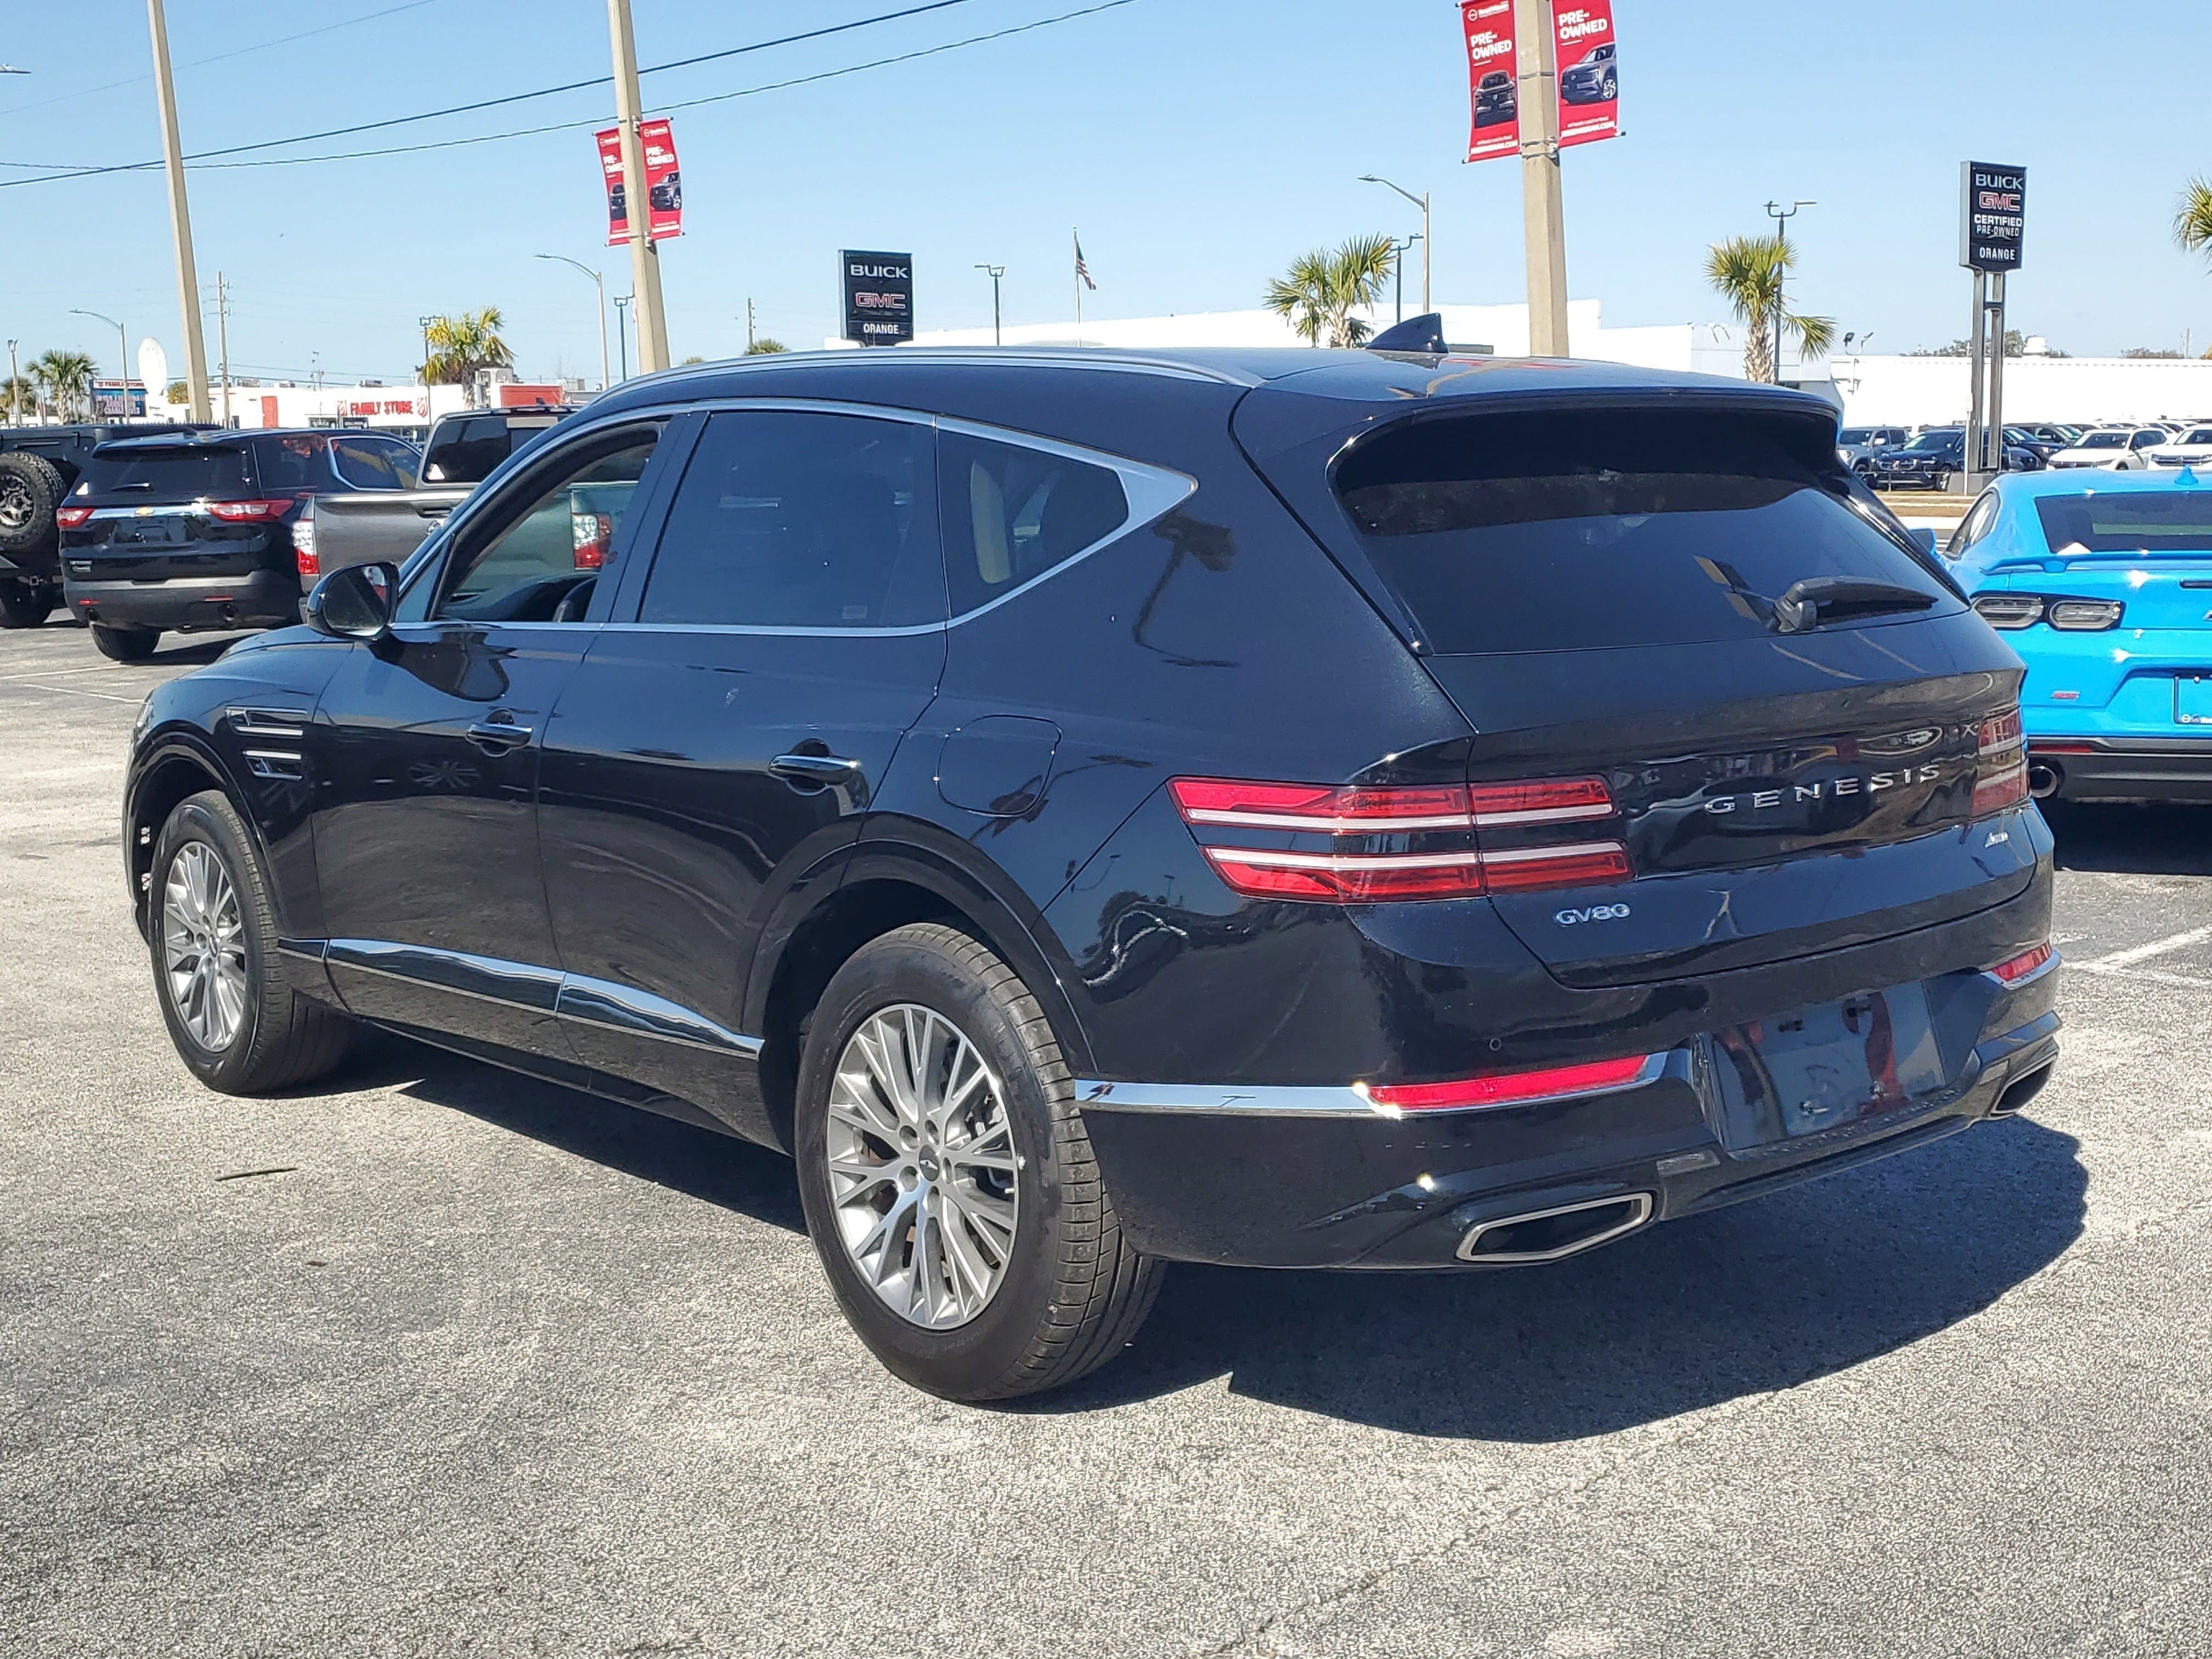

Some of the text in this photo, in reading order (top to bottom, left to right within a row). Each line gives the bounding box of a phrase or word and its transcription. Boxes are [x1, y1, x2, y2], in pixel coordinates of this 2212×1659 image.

[1559, 9, 1590, 26] PRE-
[1560, 18, 1607, 40] OWNED
[1470, 31, 1498, 47] PRE-
[1472, 40, 1513, 60] OWNED
[647, 153, 675, 166] OWNED
[1976, 173, 2023, 190] BUICK
[1979, 191, 2021, 212] GMC
[1974, 214, 2023, 227] CERTIFIED
[1976, 225, 2019, 236] PRE-OWNED
[1979, 247, 2016, 260] ORANGE
[850, 264, 909, 278] BUICK
[855, 292, 906, 309] GMC
[863, 323, 900, 334] ORANGE
[350, 400, 413, 415] FAMILY STORE
[1704, 764, 1940, 814] GENESIS
[1556, 903, 1630, 925] GV80
